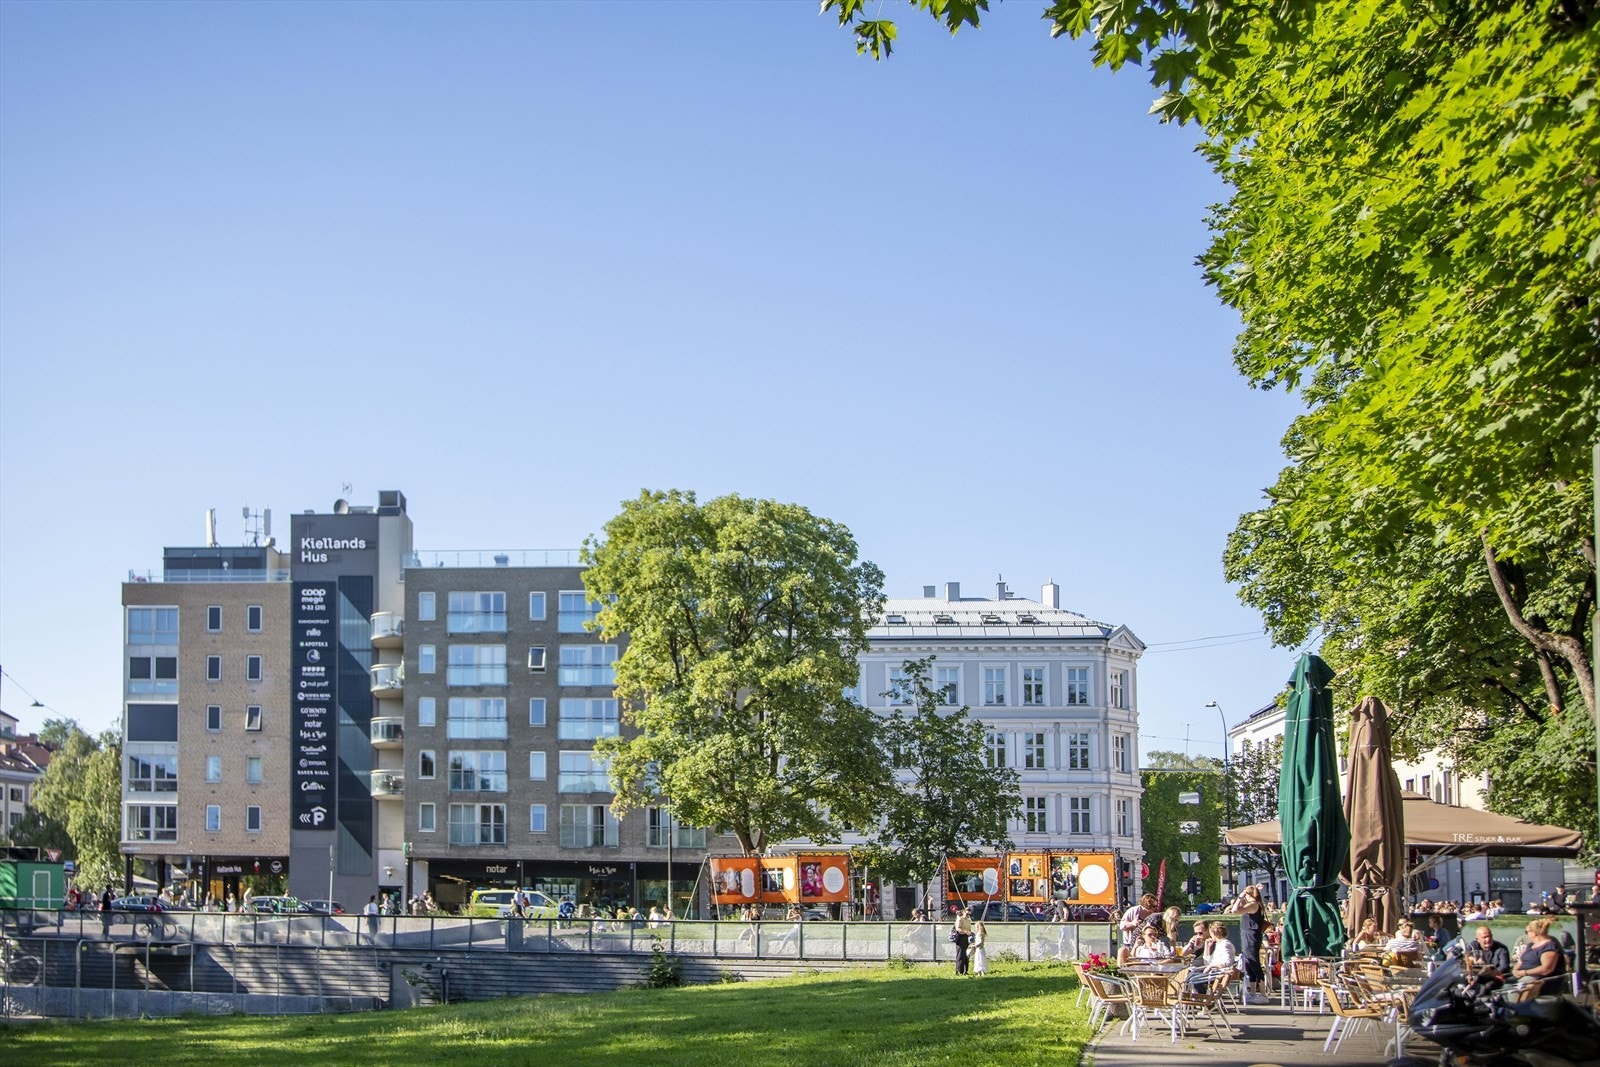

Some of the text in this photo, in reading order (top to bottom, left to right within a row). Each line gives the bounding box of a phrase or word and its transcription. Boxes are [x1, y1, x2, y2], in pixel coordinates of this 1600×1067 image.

[301, 537, 366, 549] Kiellands
[301, 551, 328, 562] Hus
[301, 588, 326, 597] coop
[301, 596, 324, 604] mega
[304, 720, 322, 728] notar
[1452, 833, 1474, 842] TRE
[1496, 835, 1505, 843] &
[486, 864, 508, 873] notar
